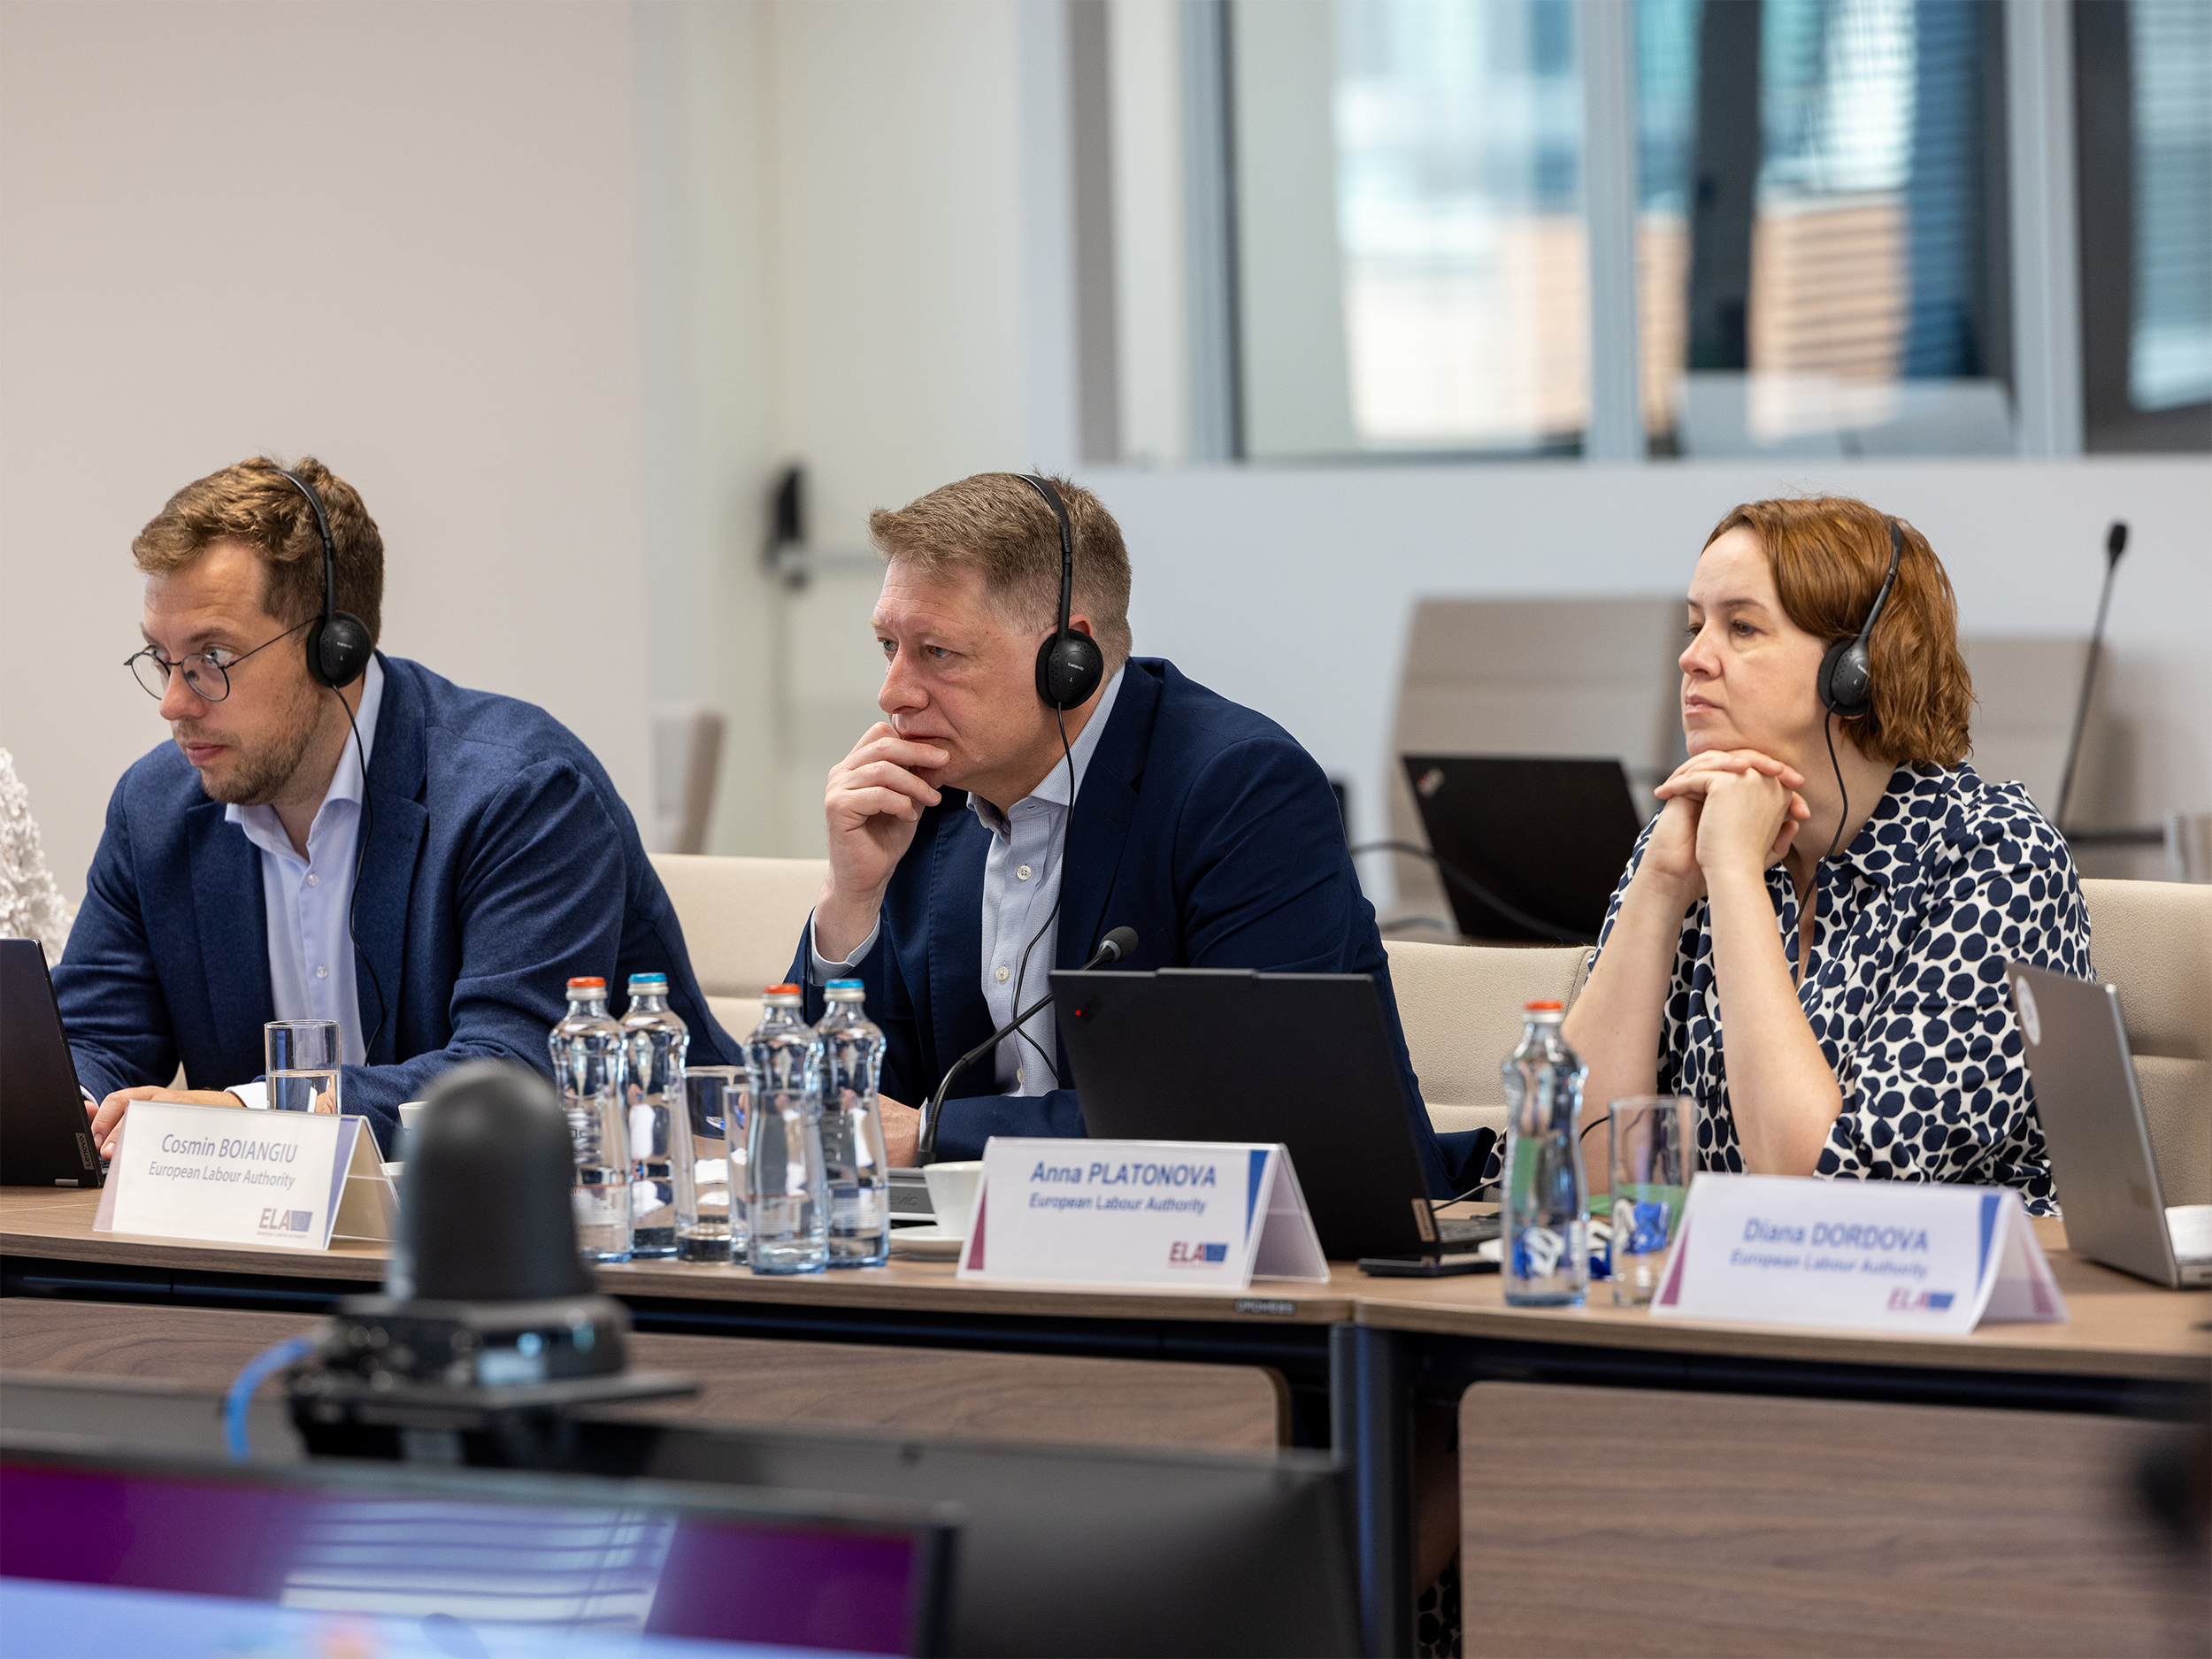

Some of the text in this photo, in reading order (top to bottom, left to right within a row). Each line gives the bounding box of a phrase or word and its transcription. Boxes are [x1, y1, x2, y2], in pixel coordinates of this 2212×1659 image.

[80, 1135, 91, 1167] Lenovo
[161, 1133, 298, 1164] Cosmin BOIANGIU
[149, 1161, 296, 1190] European Labour Authority
[1029, 1161, 1217, 1188] Anna PLATONOVA
[258, 1207, 290, 1231] ELA
[1029, 1192, 1208, 1217] European Labour Authority
[1743, 1217, 1929, 1253] Diana DORDOVA
[1168, 1240, 1204, 1263] ELA
[1730, 1248, 1929, 1280] European Labour Authority
